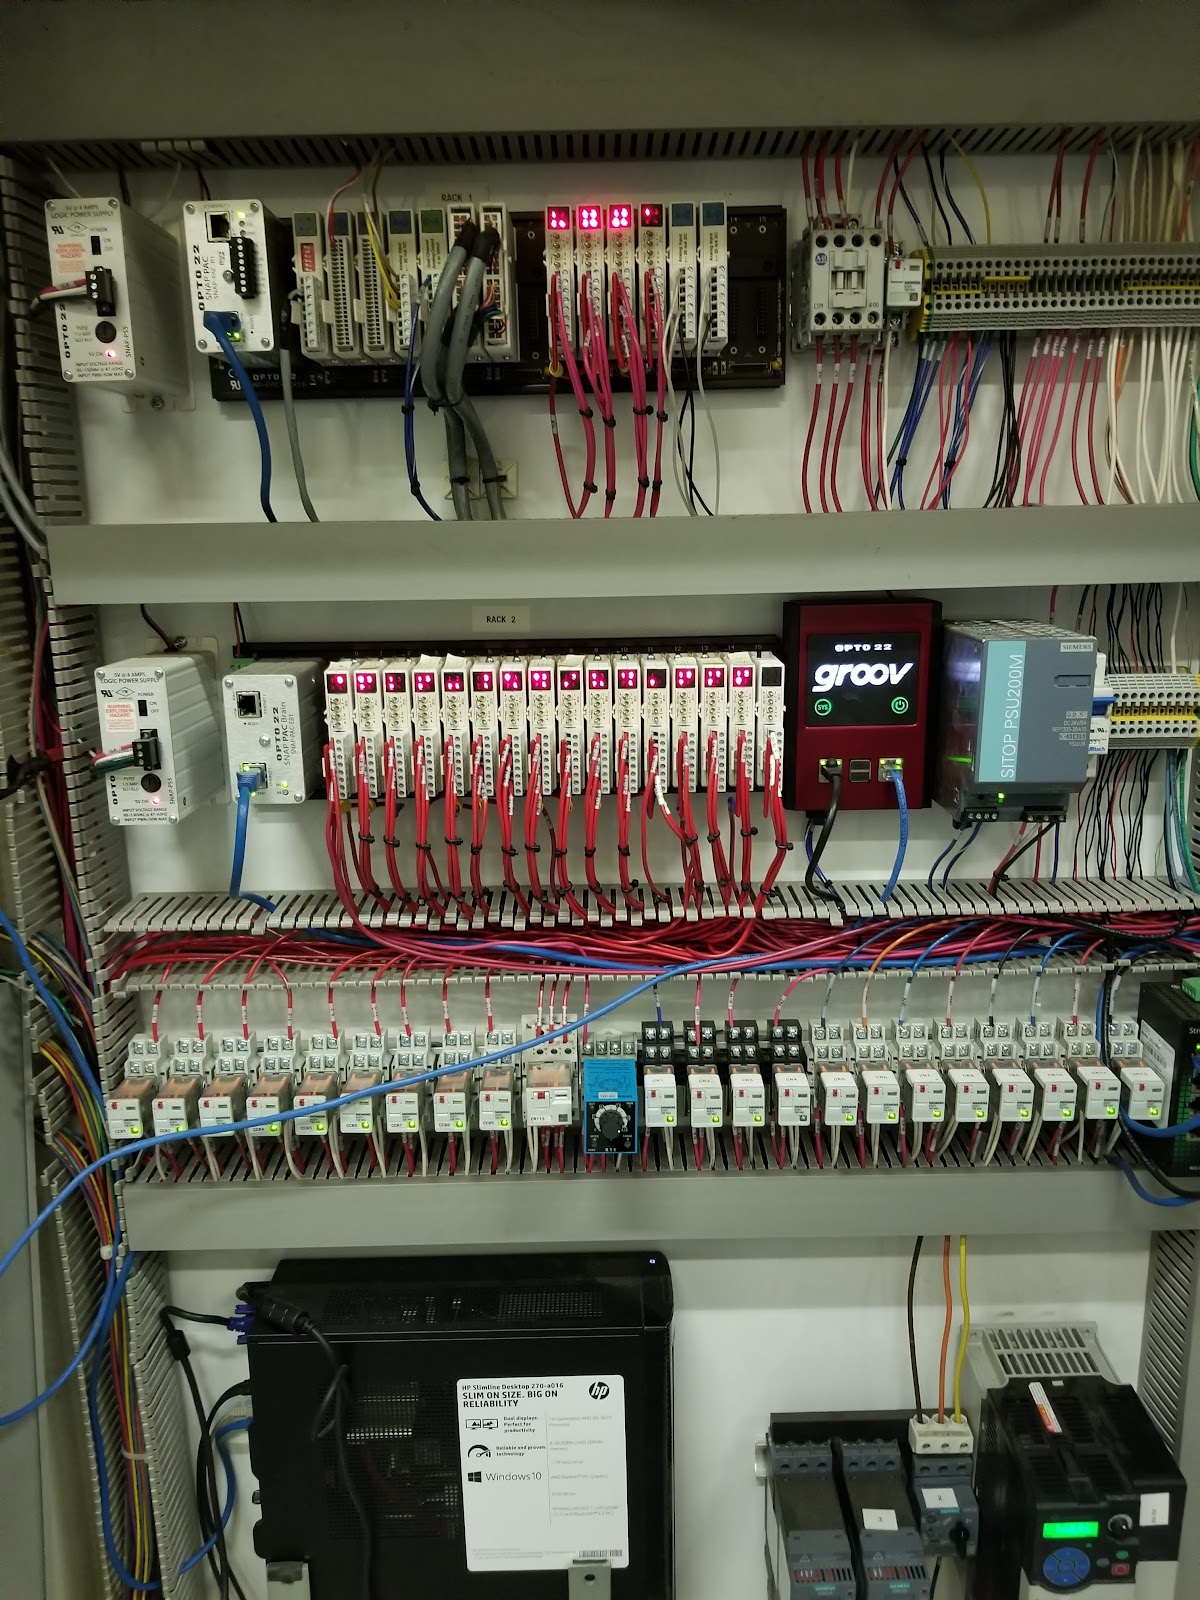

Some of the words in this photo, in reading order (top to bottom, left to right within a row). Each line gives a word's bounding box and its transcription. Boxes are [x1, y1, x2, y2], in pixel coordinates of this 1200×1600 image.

[441, 194, 463, 202] RACK
[468, 194, 472, 202] 1
[193, 244, 200, 265] 22
[201, 256, 210, 274] PAC
[195, 269, 205, 311] OPTO
[203, 276, 212, 300] SNAP
[59, 304, 67, 320] 22
[61, 324, 71, 358] OPTO
[835, 644, 871, 652] OPTO
[874, 643, 892, 651] 22
[812, 663, 914, 692] groov
[1004, 654, 1023, 729] PSU200M
[272, 707, 280, 724] 22
[280, 701, 288, 723] Brain
[281, 724, 289, 742] PAC
[274, 727, 283, 761] OPTO
[283, 744, 291, 766] SNAP
[1001, 733, 1016, 778] SITOP
[110, 775, 118, 805] OPTO
[463, 1391, 484, 1399] SLIM
[486, 1391, 500, 1399] ON
[527, 1390, 542, 1398] BIG
[589, 1381, 610, 1400] hp
[463, 1399, 519, 1408] RELIABILITY
[485, 1472, 531, 1481] Windows
[531, 1471, 542, 1480] 10
